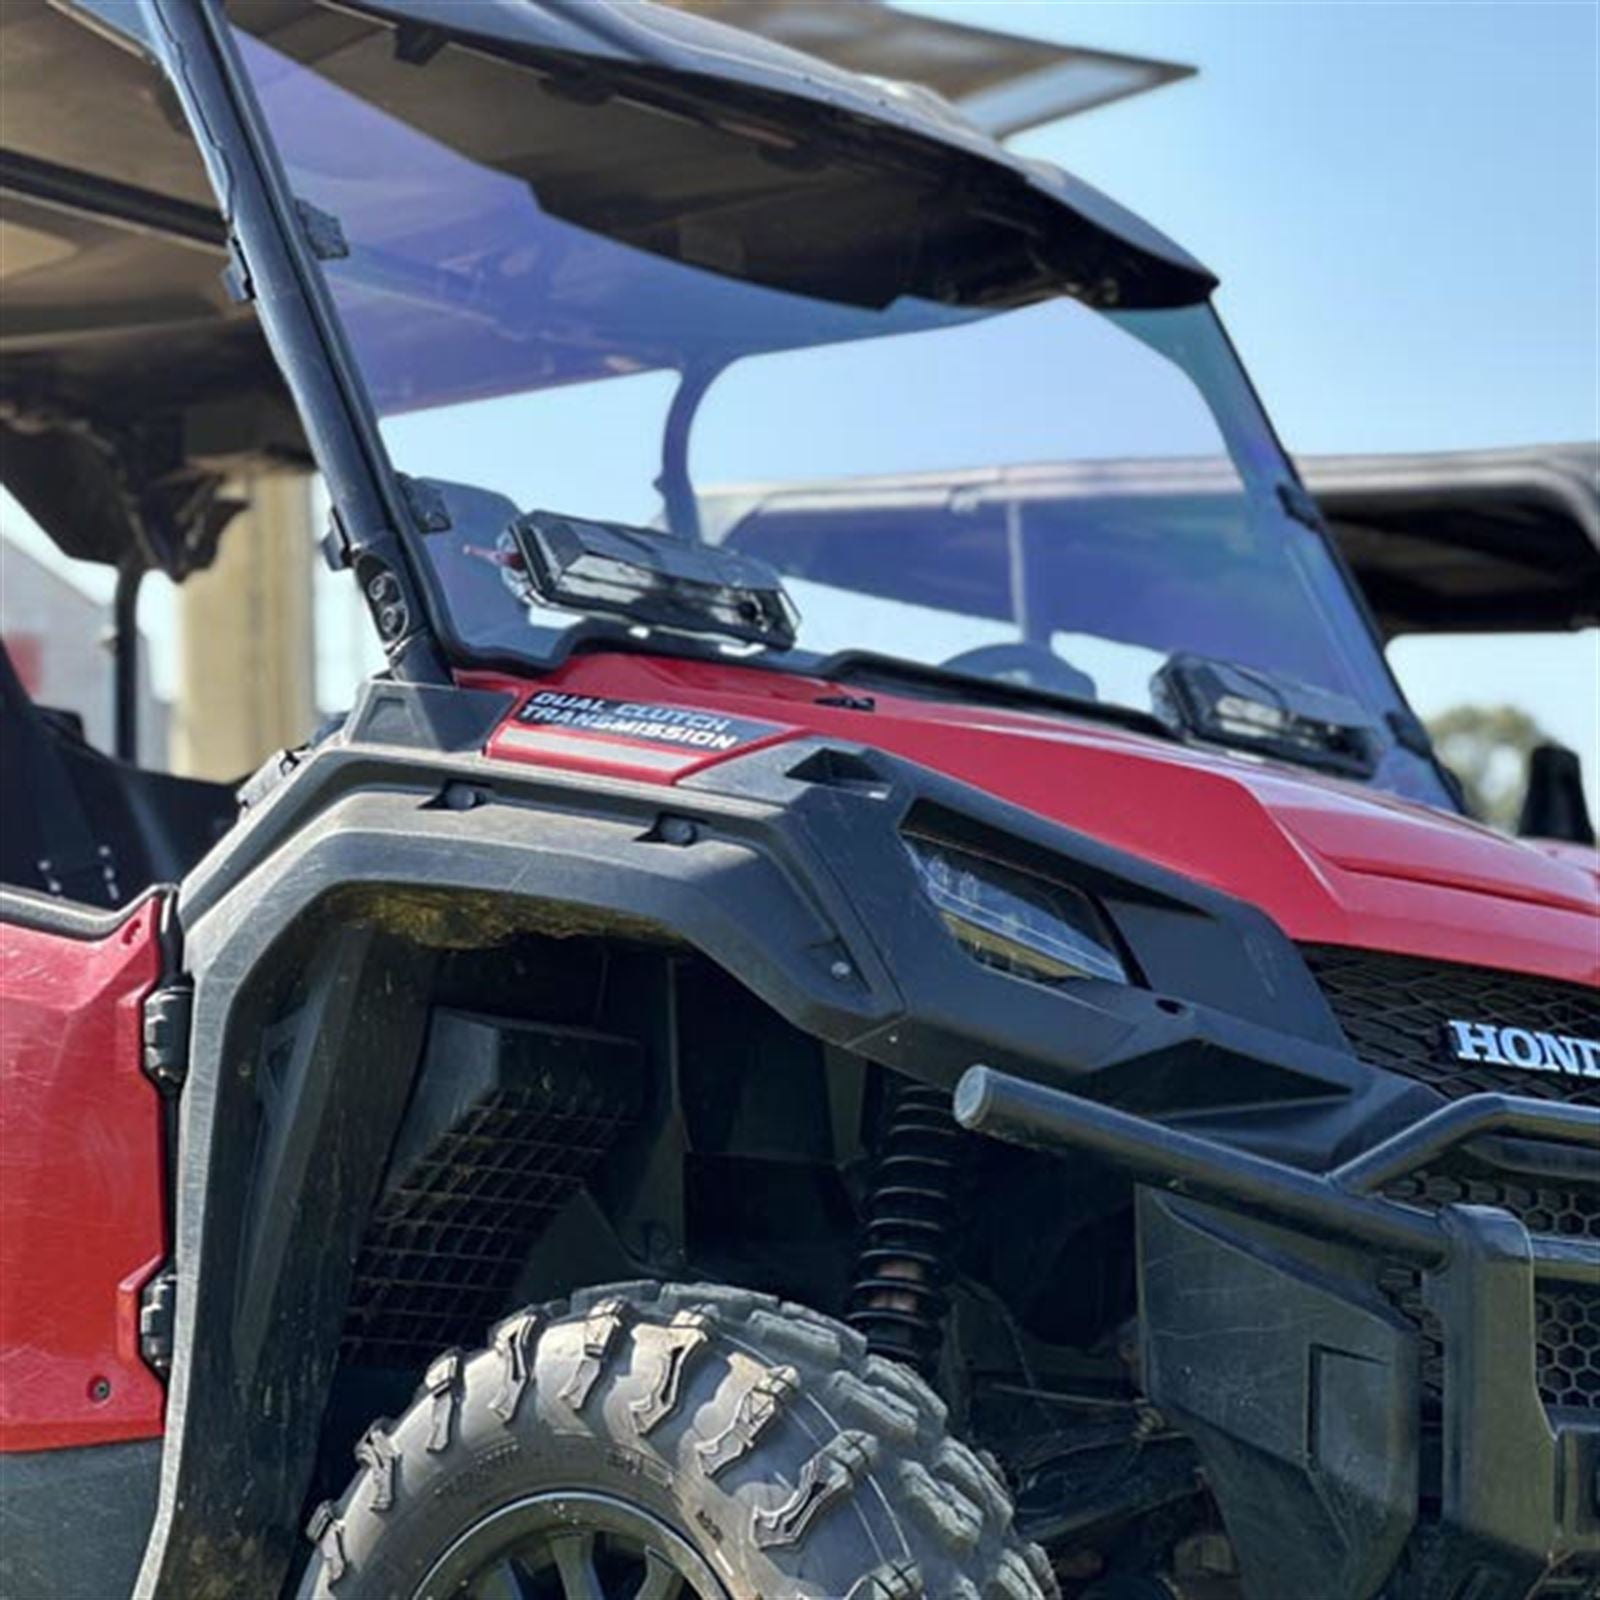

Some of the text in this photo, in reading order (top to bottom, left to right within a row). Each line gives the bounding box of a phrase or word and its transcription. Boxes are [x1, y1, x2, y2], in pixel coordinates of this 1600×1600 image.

[521, 705, 739, 749] TRANSMISSION
[533, 692, 729, 731] DUAL CLUTCH
